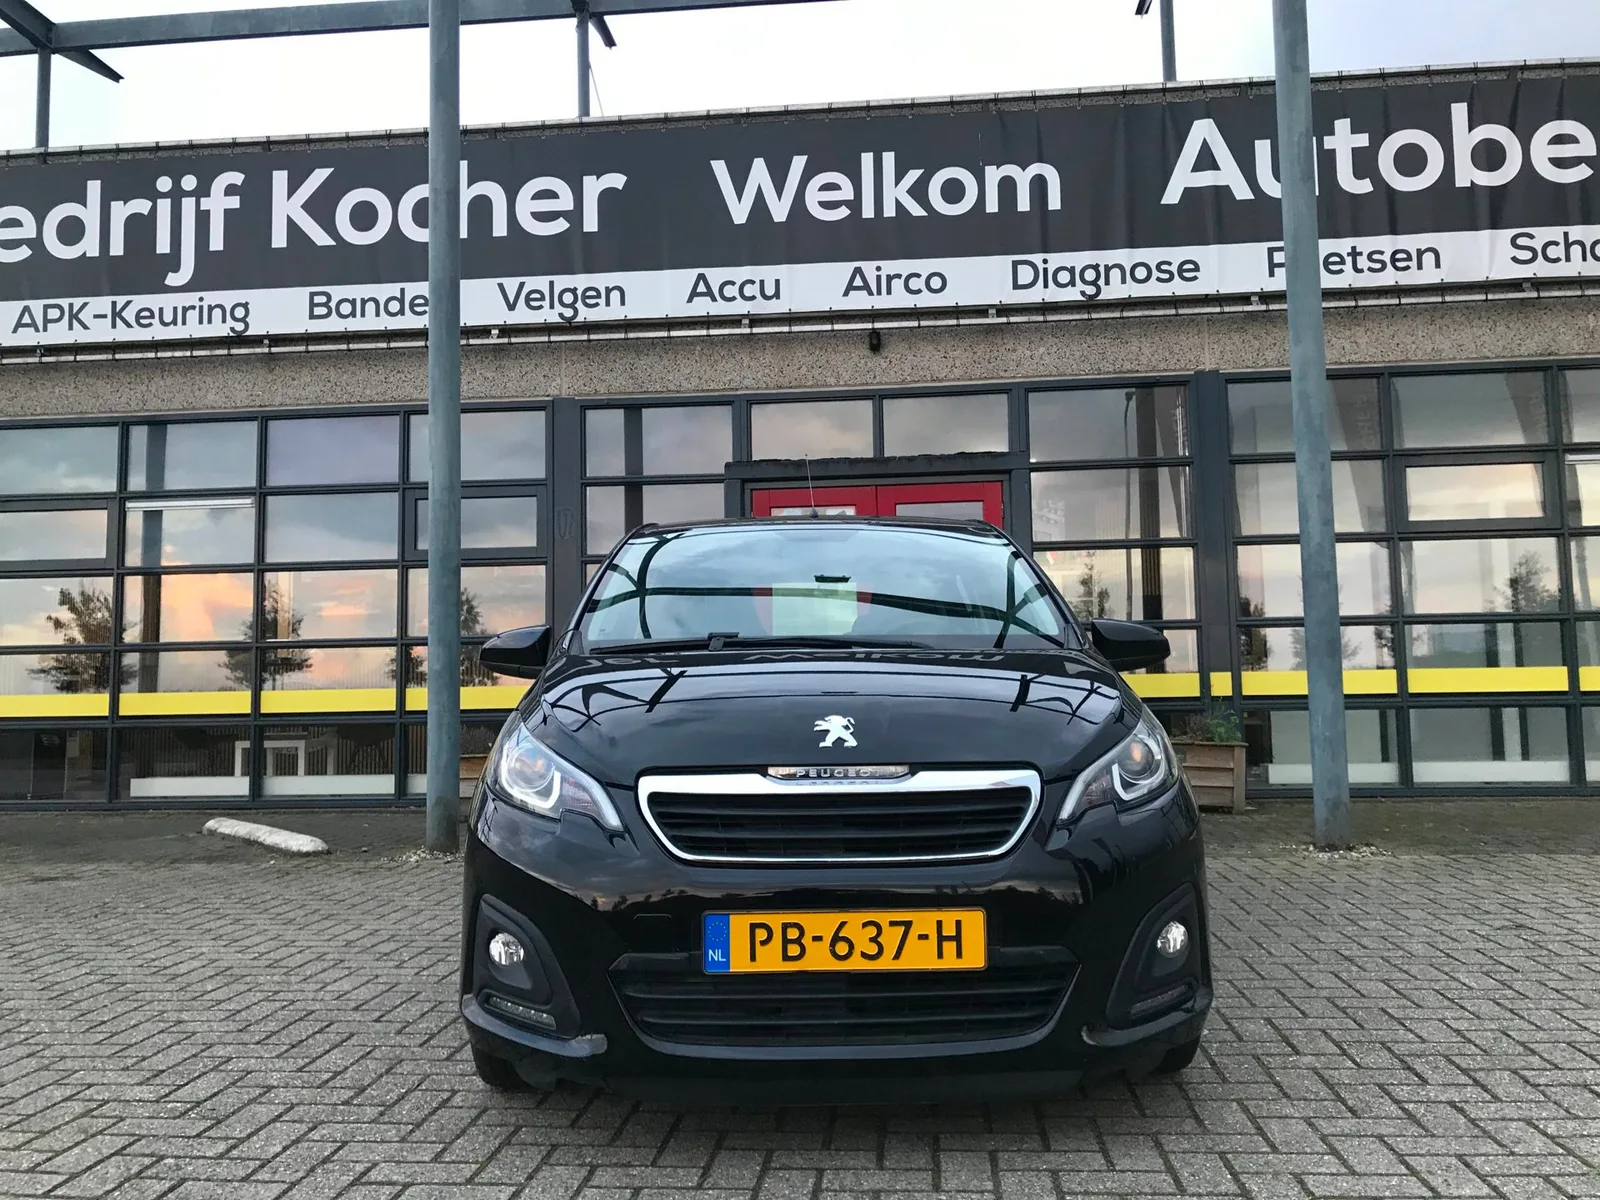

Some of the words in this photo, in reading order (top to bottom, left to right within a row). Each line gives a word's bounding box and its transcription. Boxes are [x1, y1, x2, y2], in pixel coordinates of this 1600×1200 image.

[0, 171, 245, 287] edrijf
[271, 160, 628, 249] Kocher
[710, 150, 1062, 225] Welkom
[1160, 102, 1598, 205] Autobe
[11, 296, 250, 336] APK-Keuring
[497, 279, 626, 322] Velgen
[686, 273, 781, 304] Accu
[843, 266, 948, 298] Airco
[1011, 258, 1201, 299] Diagnose
[1267, 244, 1441, 278] Fetsen
[708, 949, 726, 963] NL
[748, 918, 963, 963] PB-637-H
